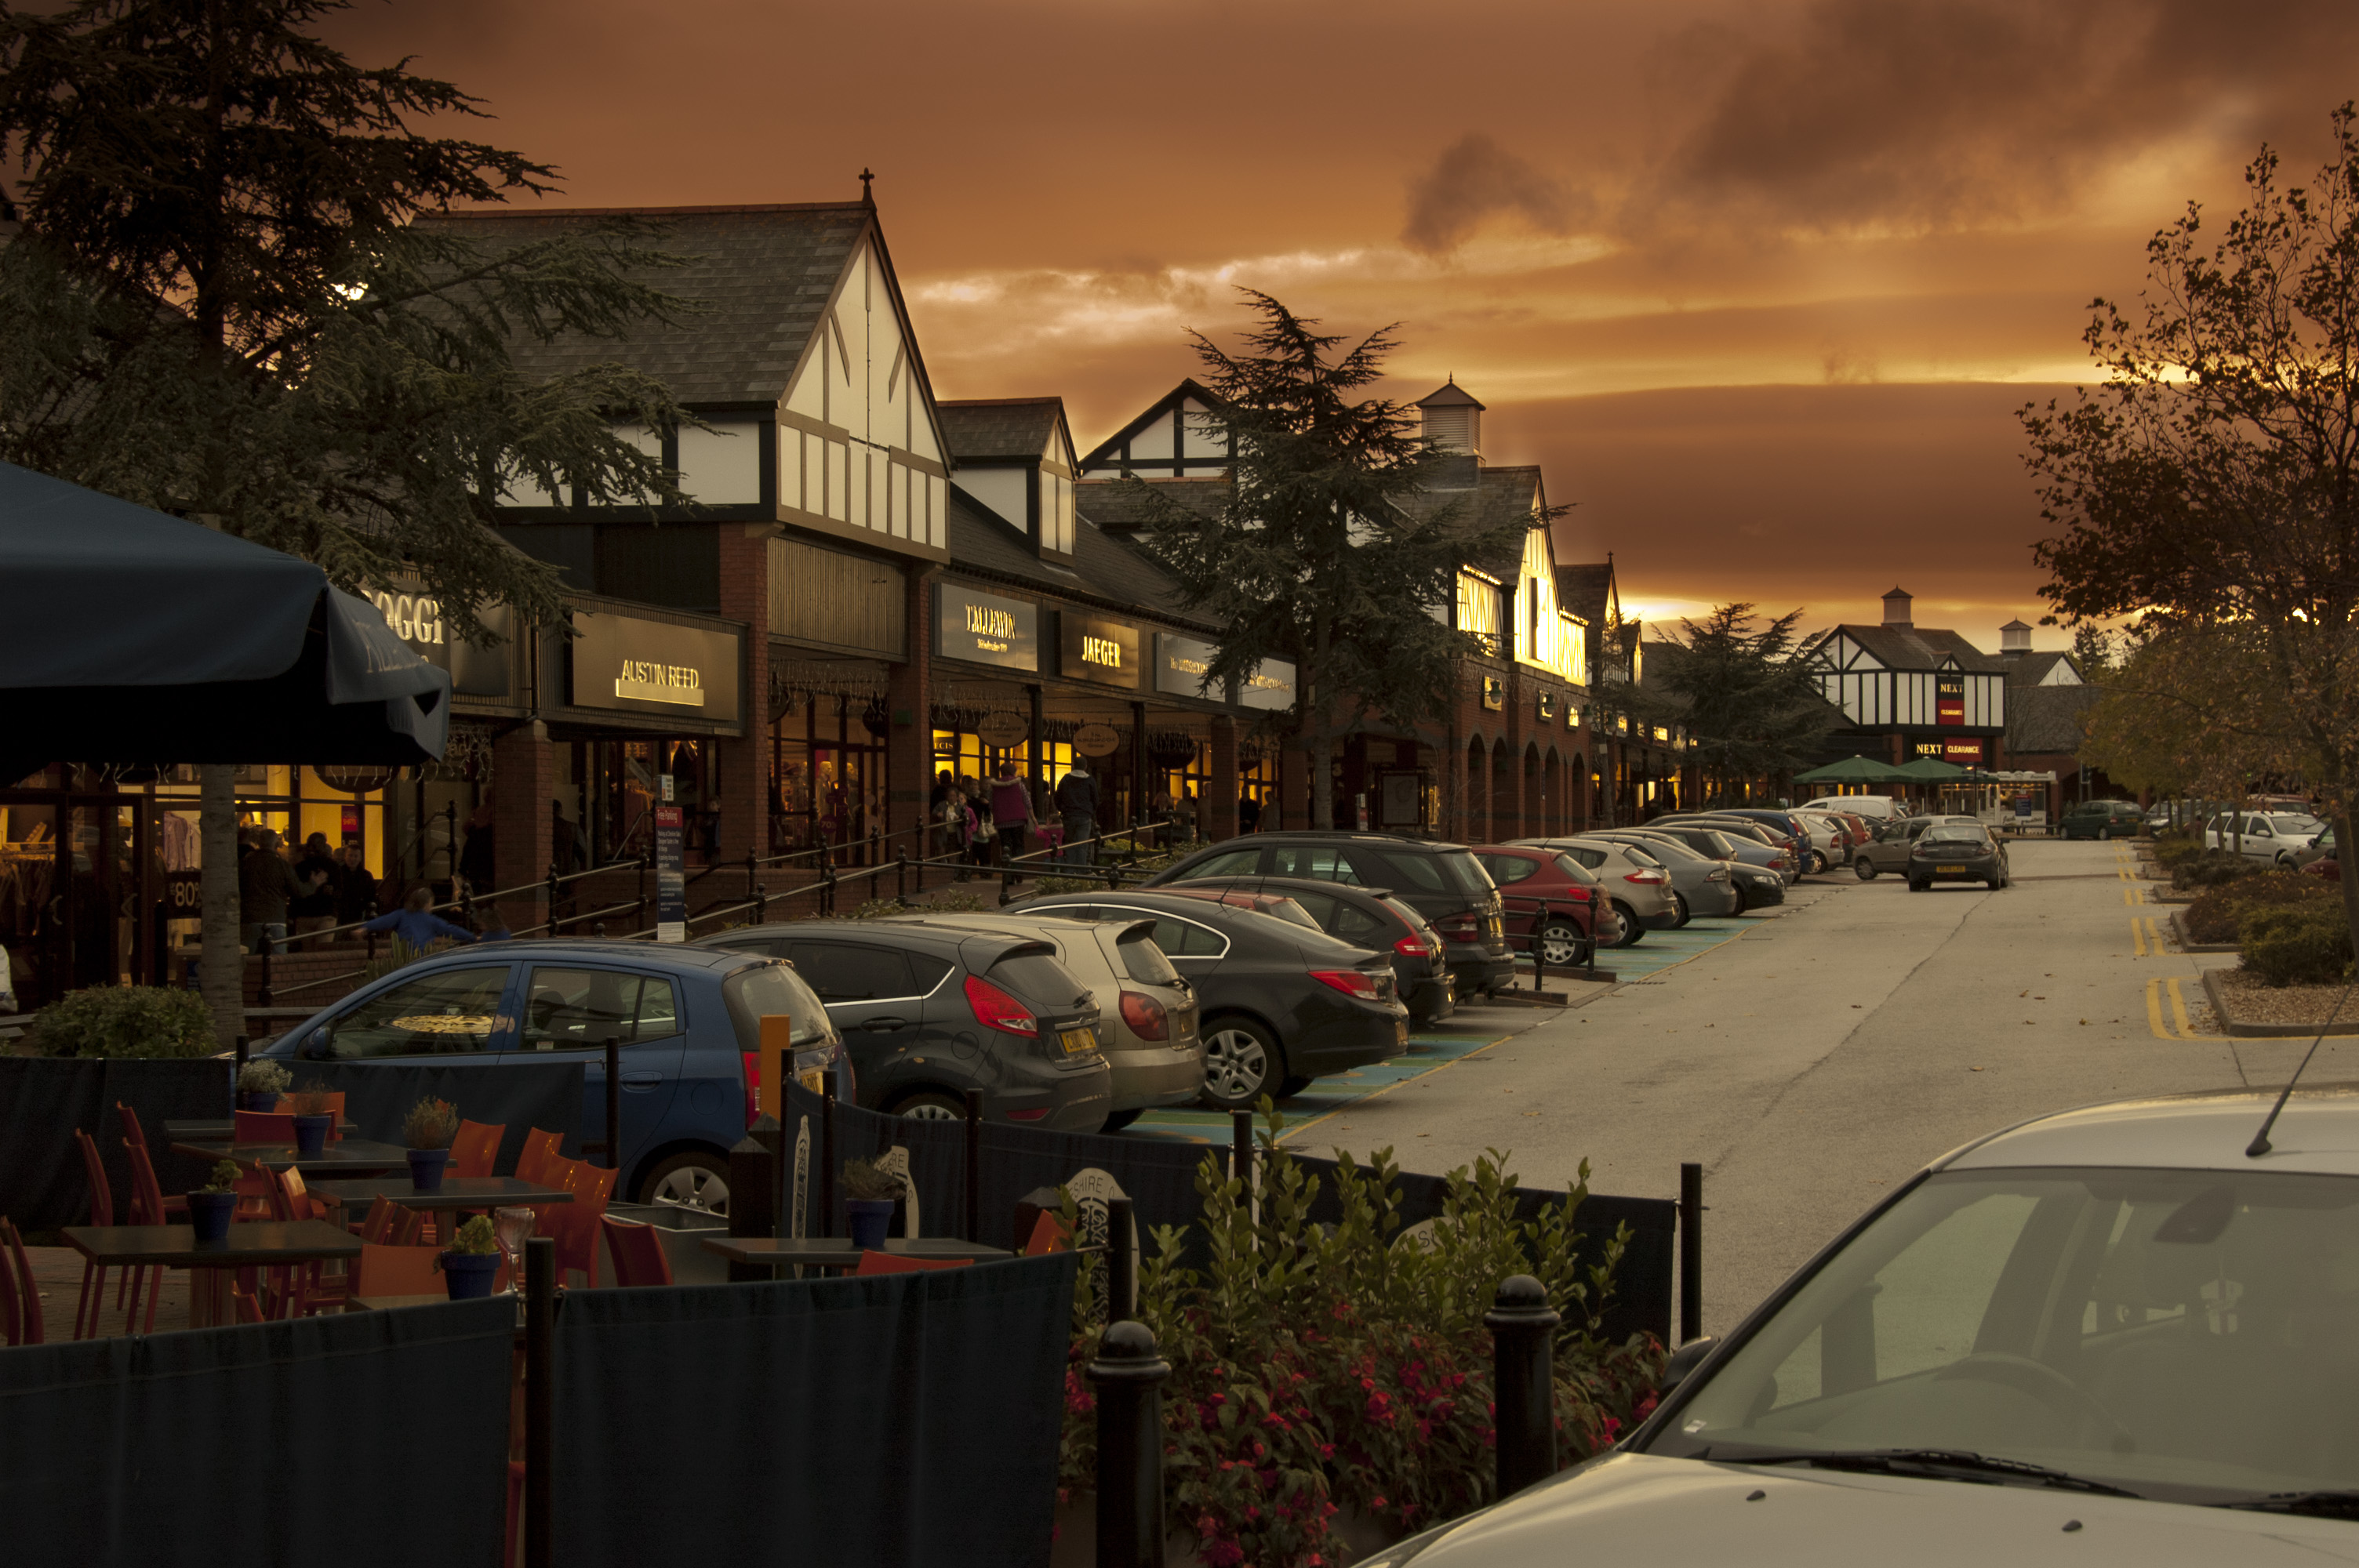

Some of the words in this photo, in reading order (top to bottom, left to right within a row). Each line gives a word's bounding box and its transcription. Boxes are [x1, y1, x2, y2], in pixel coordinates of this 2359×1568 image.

[360, 589, 444, 644] OGGI
[1082, 636, 1121, 667] JAEGER
[622, 659, 667, 686] AUSTIN
[668, 665, 700, 689] REED
[1939, 683, 1964, 693] NEXT
[1916, 743, 1943, 754] NEXT
[1946, 745, 1979, 754] CLEARANCE
